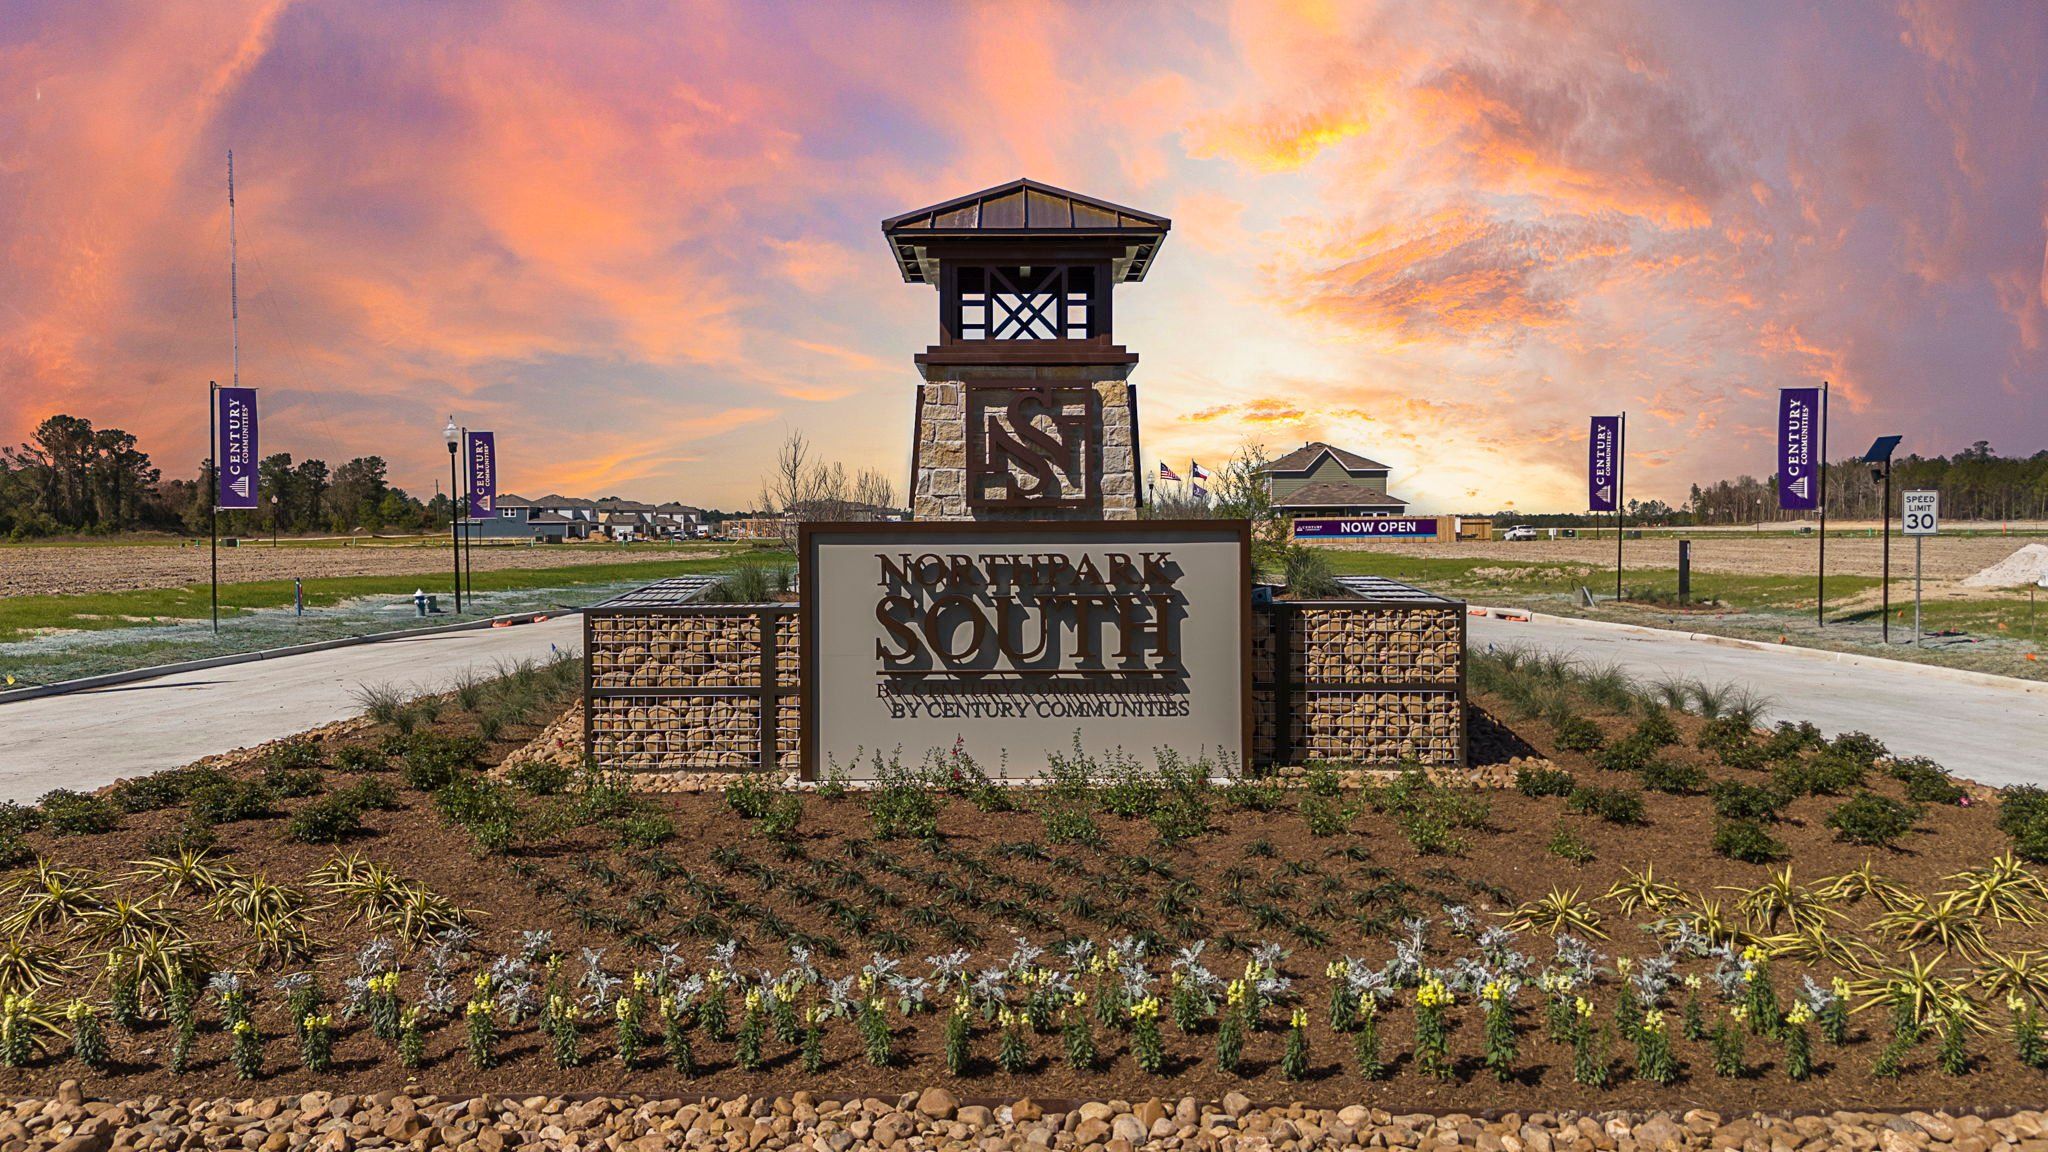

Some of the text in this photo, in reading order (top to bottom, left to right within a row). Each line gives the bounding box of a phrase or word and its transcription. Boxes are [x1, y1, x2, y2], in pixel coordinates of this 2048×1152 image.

[229, 398, 241, 475] CENTURY
[1596, 424, 1606, 485] CENTURY
[1788, 399, 1801, 476] CENTURY
[1801, 407, 1809, 465] COMMUNITIES
[475, 439, 485, 495] CENTURY
[1340, 521, 1416, 532] NOW OPEN
[1906, 495, 1935, 503] SPEED
[1906, 513, 1934, 529] 30
[874, 552, 1176, 587] NORTHPARK
[875, 593, 1178, 661] SOUTH
[891, 700, 1190, 718] BY CENTURY COMMUNITIES
